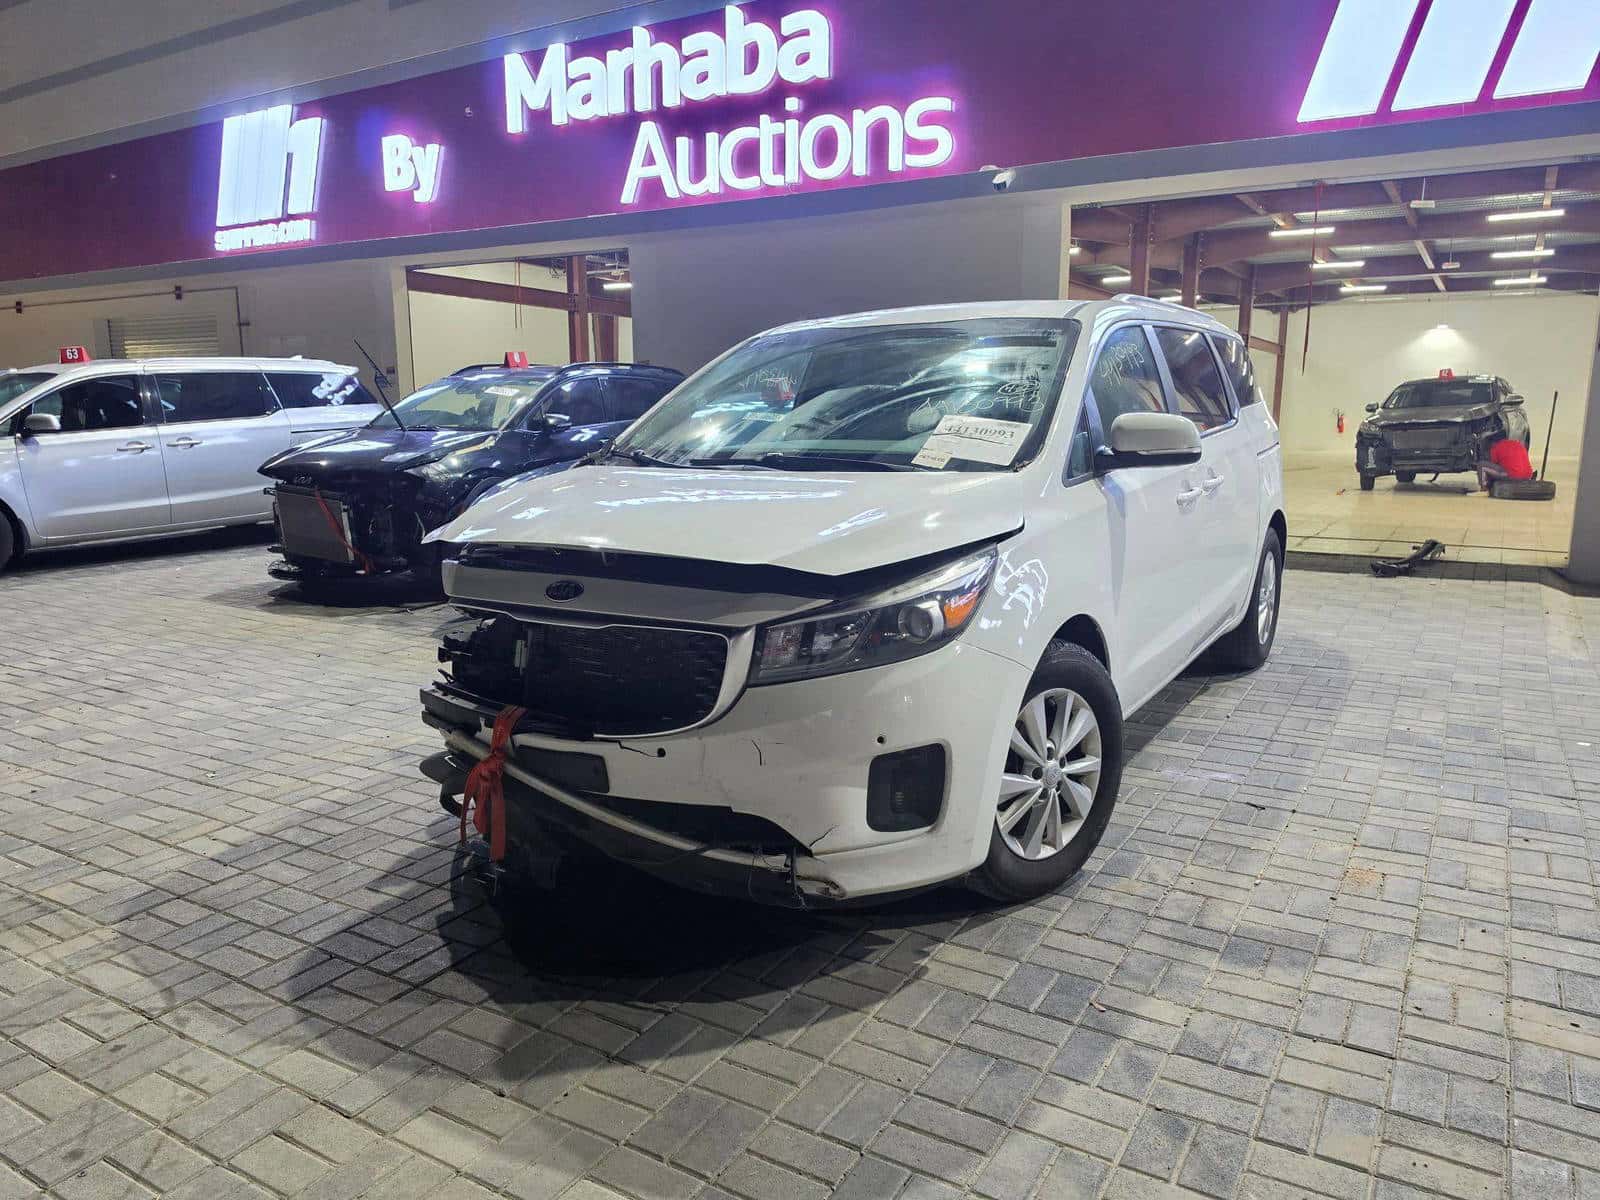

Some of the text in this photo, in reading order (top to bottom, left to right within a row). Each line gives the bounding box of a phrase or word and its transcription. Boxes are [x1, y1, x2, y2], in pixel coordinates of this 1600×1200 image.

[503, 4, 832, 134] Marhaba
[381, 134, 442, 203] By
[619, 96, 955, 204] Auctions
[66, 348, 79, 360] 63
